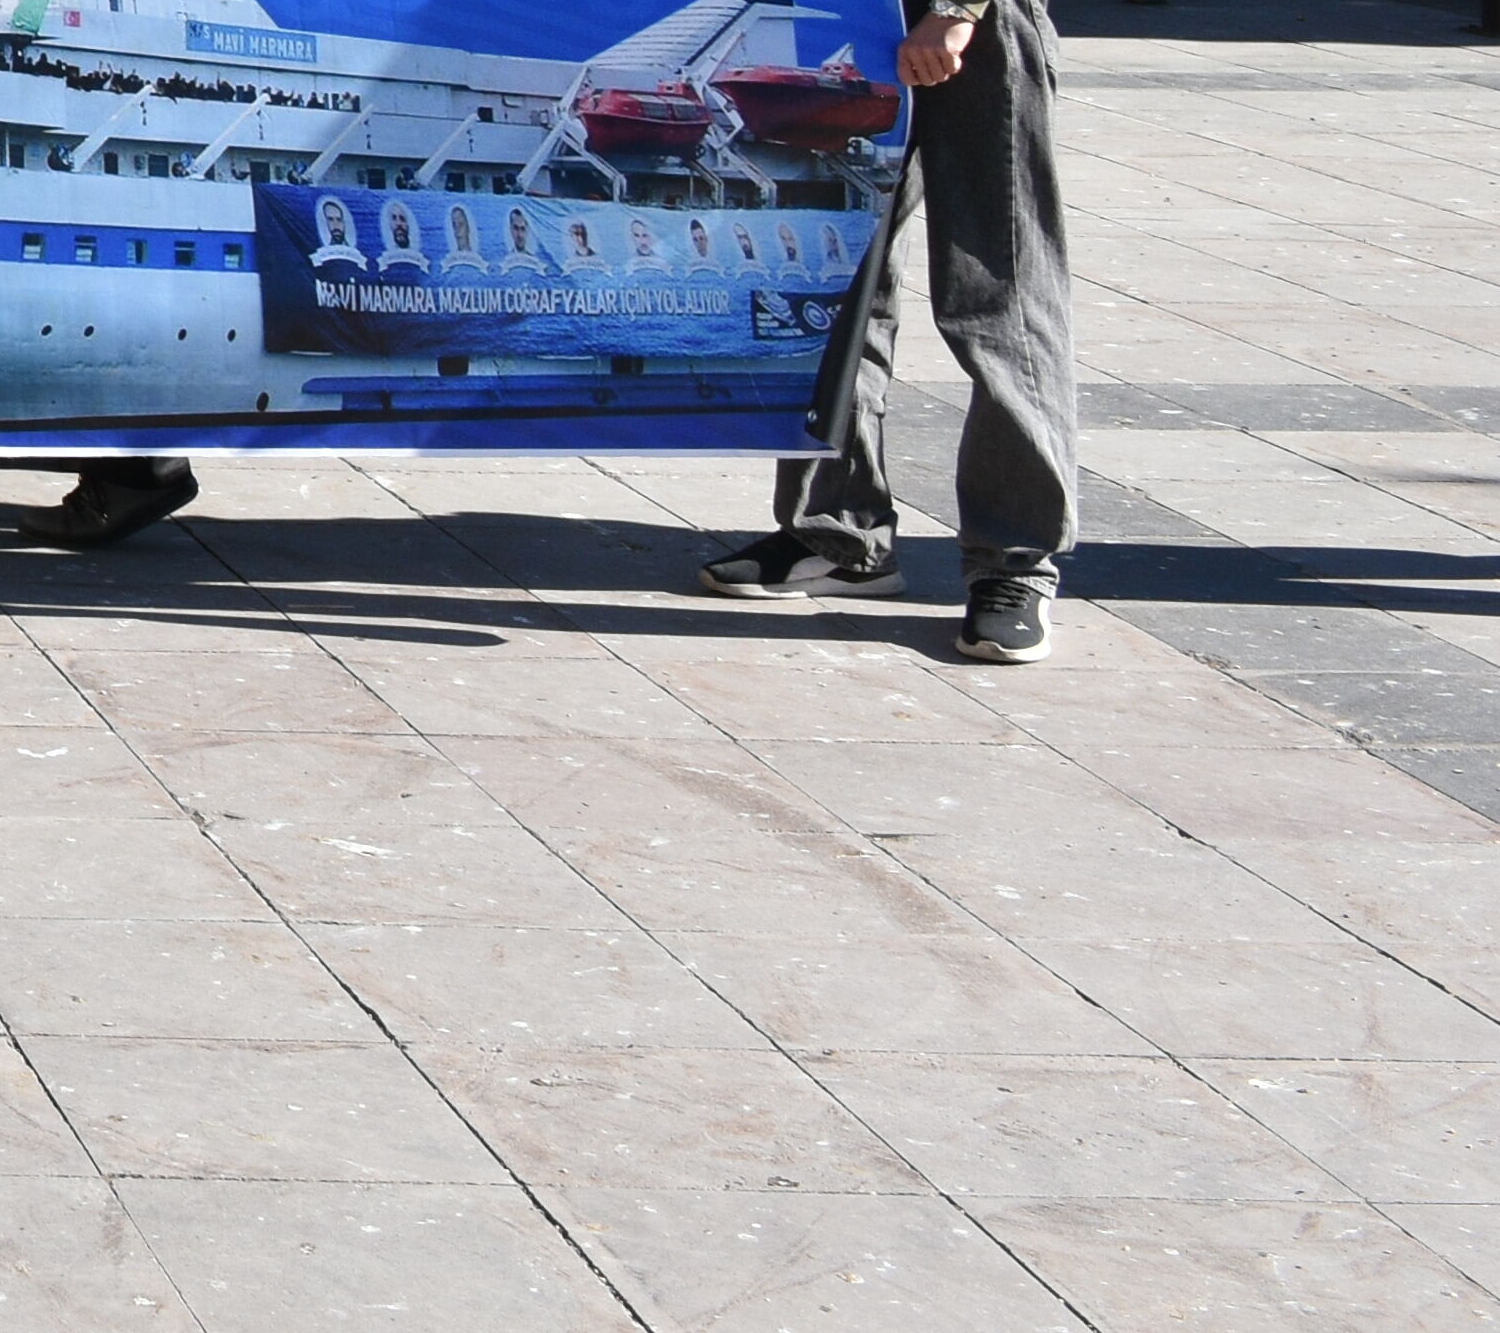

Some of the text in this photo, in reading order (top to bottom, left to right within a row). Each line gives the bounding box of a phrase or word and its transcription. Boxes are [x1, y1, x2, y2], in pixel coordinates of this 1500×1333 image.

[213, 28, 245, 54] MAVİ
[248, 34, 314, 62] MARMARA
[315, 277, 732, 322] MAVİ MARMARA MAZLUM COĞRAFYALAR İÇİN YOL ALIYOR
